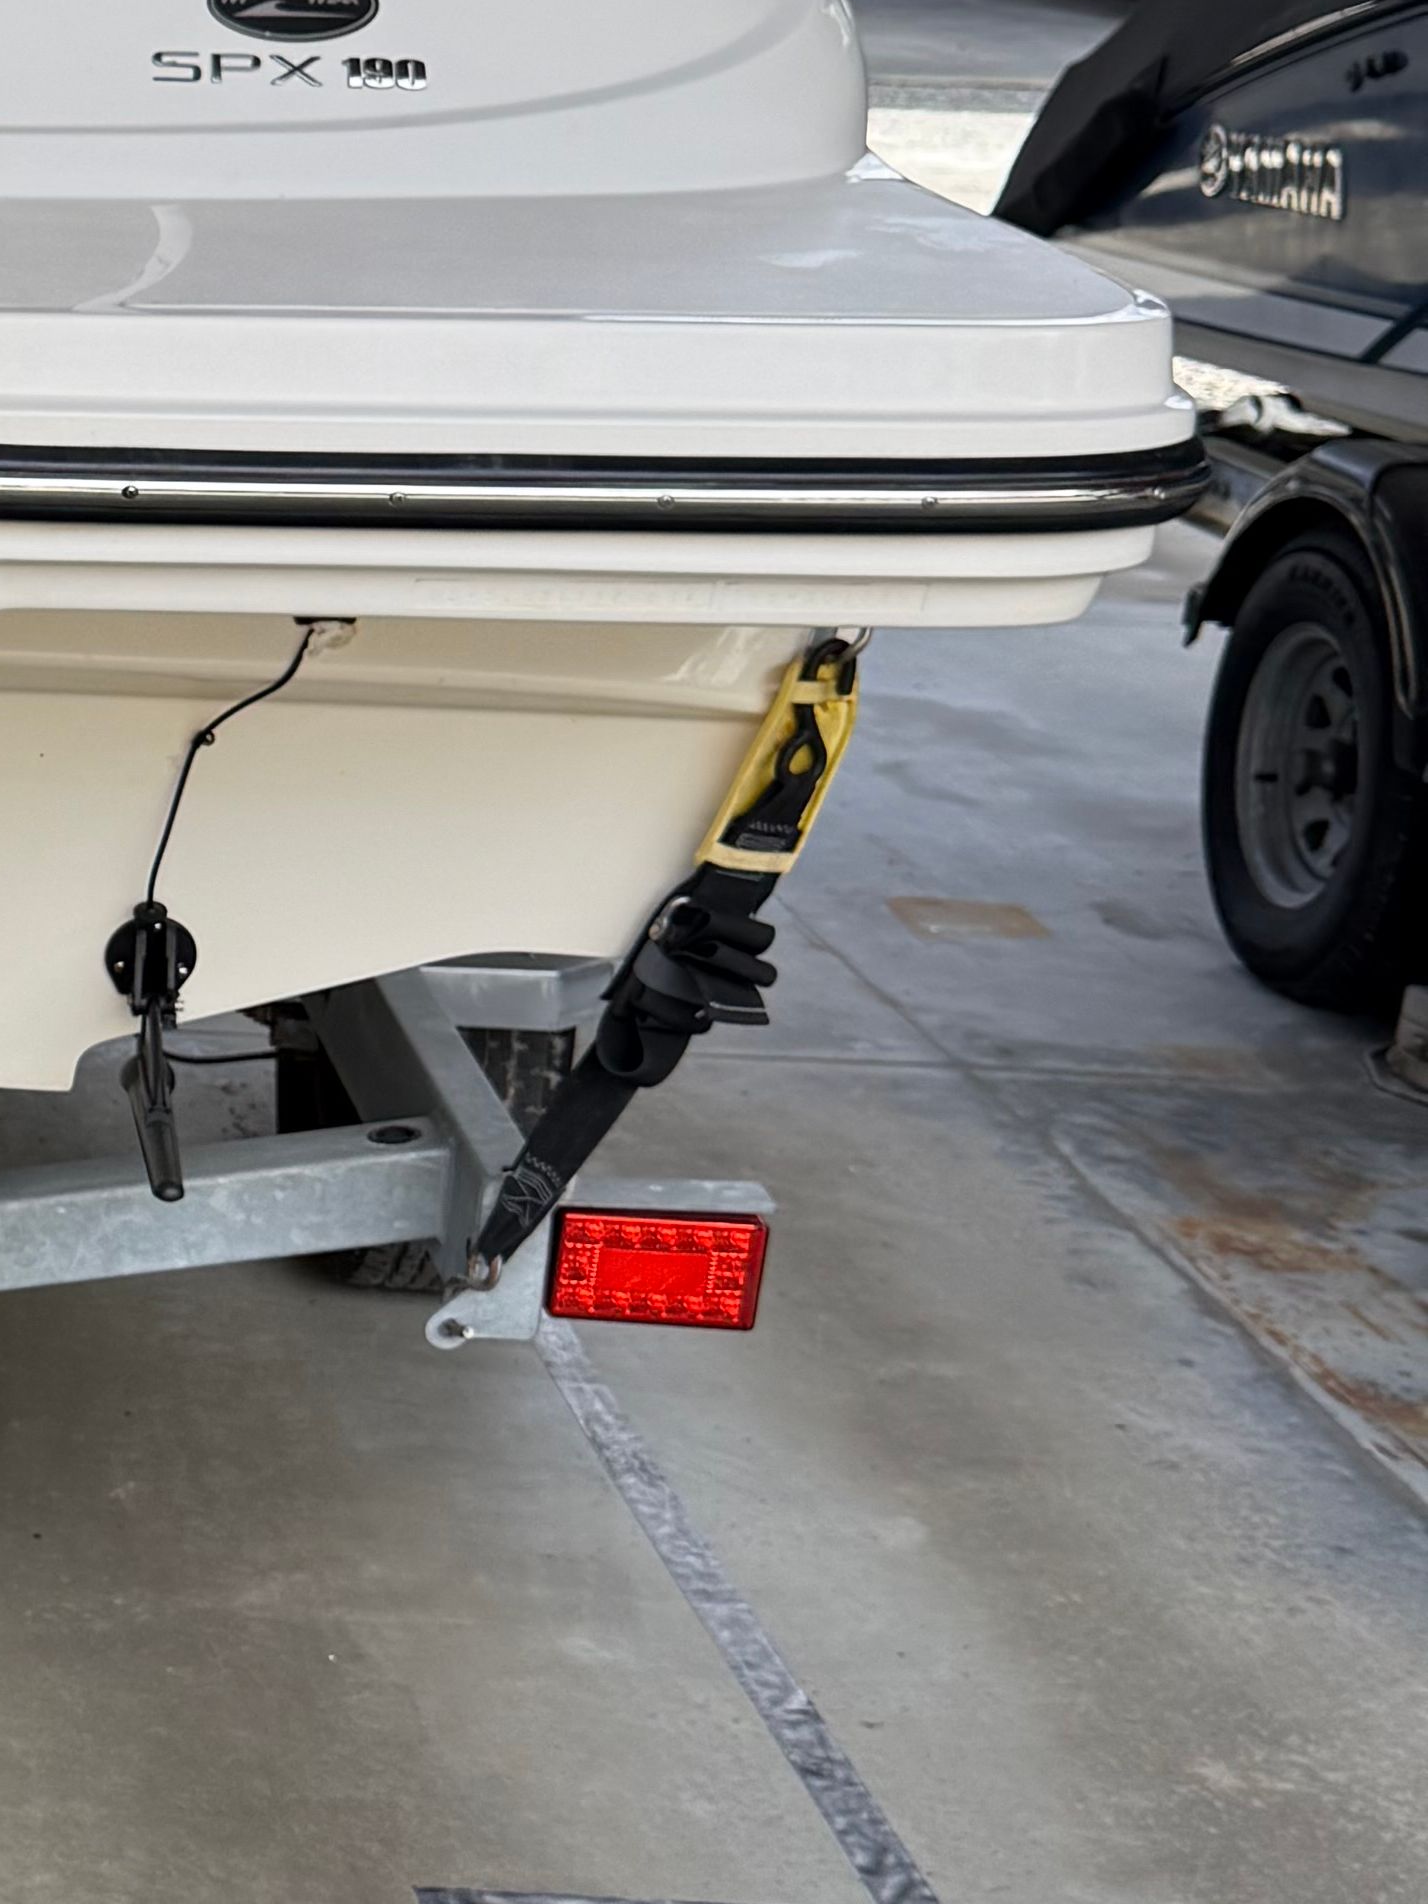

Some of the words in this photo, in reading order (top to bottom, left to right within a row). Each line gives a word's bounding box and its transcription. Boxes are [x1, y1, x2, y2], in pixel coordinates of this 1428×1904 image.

[151, 50, 324, 88] SPX
[341, 55, 429, 91] 190
[1227, 132, 1346, 220] YAMAHA
